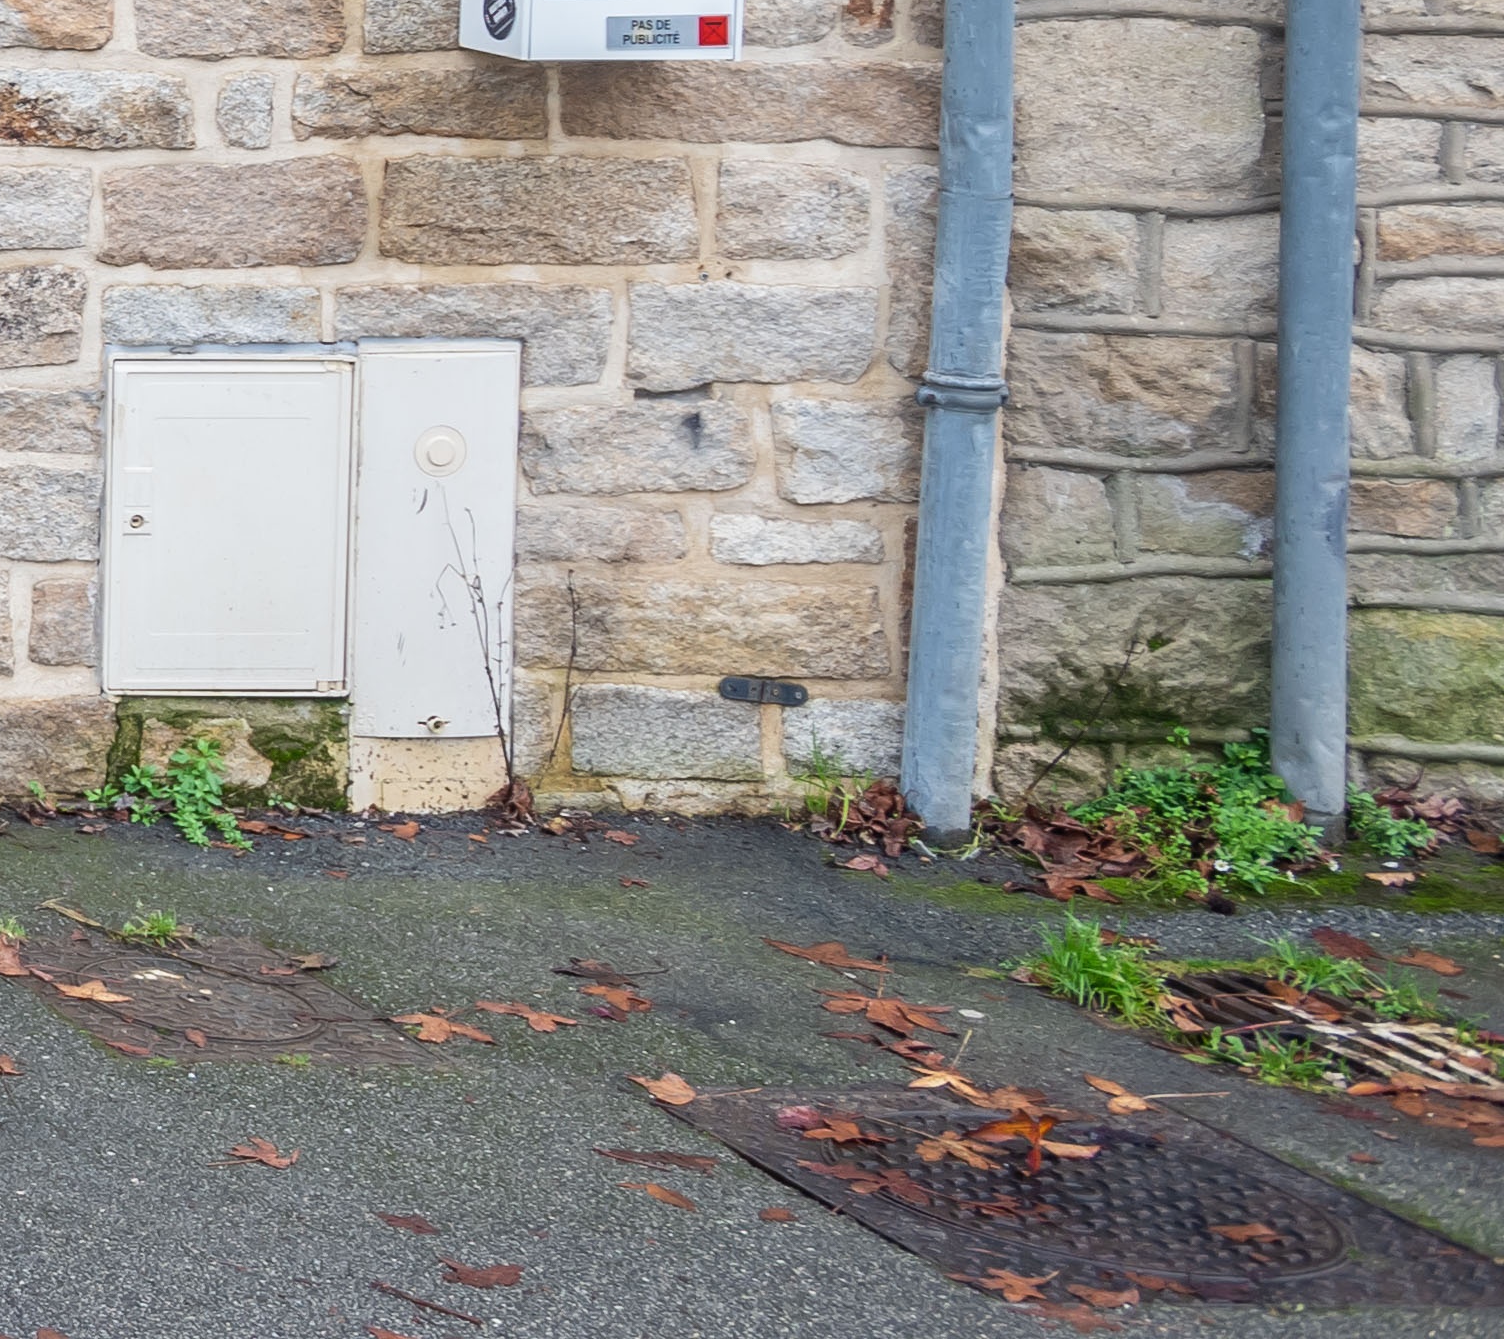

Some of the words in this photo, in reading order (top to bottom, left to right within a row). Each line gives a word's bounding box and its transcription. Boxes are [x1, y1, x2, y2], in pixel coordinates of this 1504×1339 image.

[631, 19, 653, 31] PAS
[655, 19, 671, 31] DE
[622, 29, 680, 45] PUBLICITÉ
